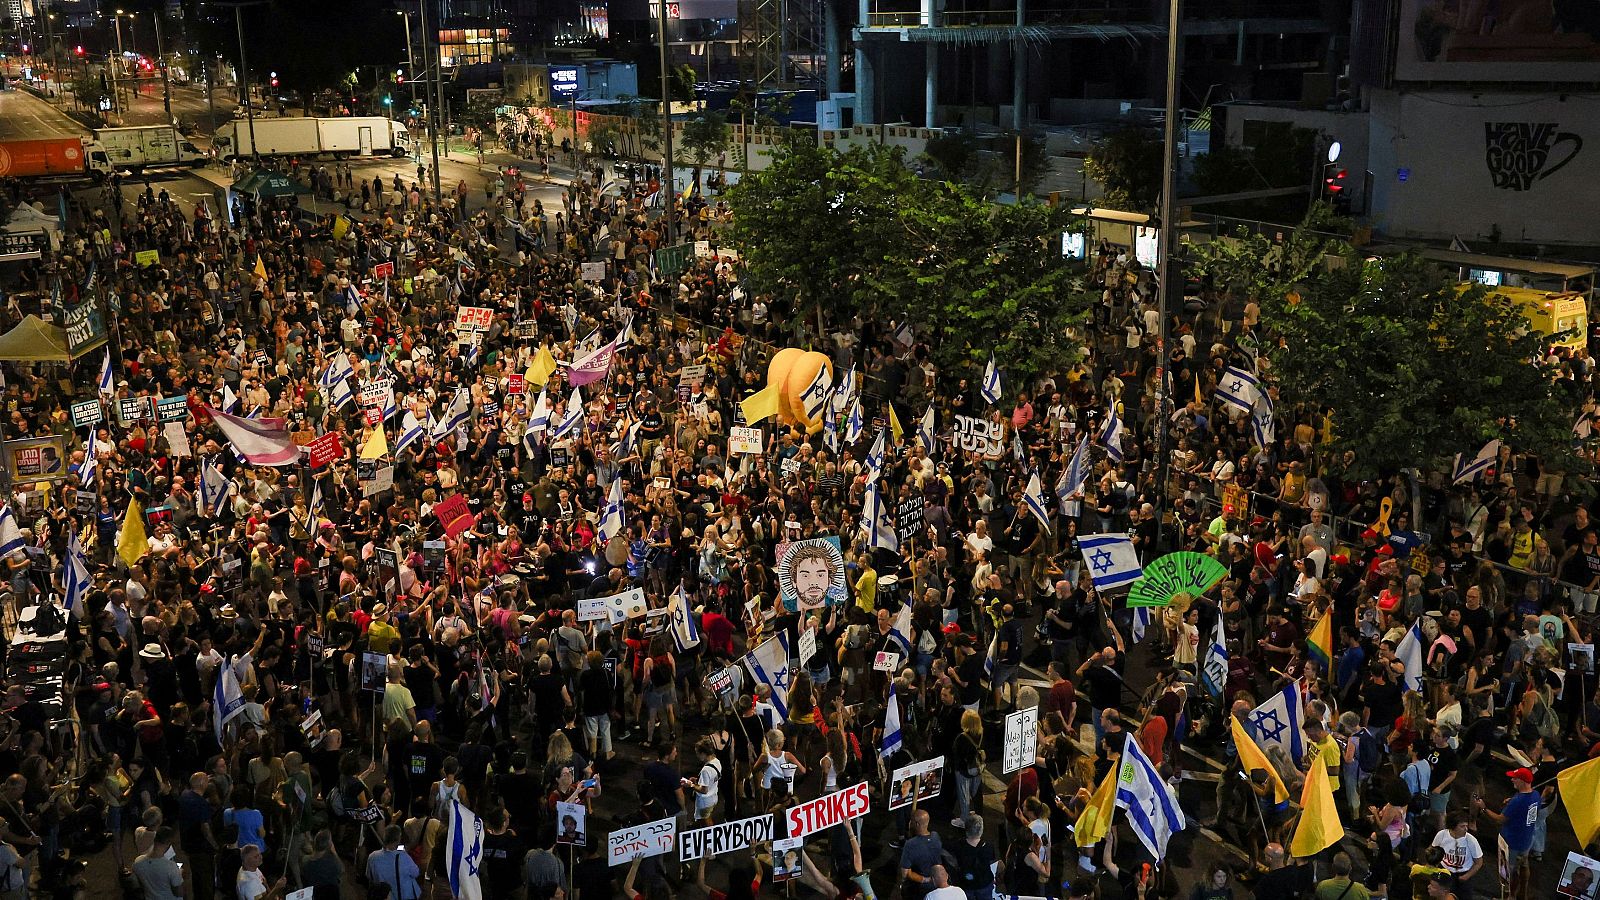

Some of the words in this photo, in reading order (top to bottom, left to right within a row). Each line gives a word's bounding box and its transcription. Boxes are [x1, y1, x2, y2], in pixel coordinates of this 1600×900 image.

[1486, 147, 1548, 174] GOOD
[1492, 170, 1538, 191] DAY
[953, 414, 1003, 440] שביתה
[952, 431, 1003, 456] עכשיו
[790, 784, 869, 838] STRIKES
[647, 823, 673, 834] כבר
[681, 816, 774, 860] EVERYBODY
[613, 839, 649, 857] אדום
[657, 835, 673, 851] קו
